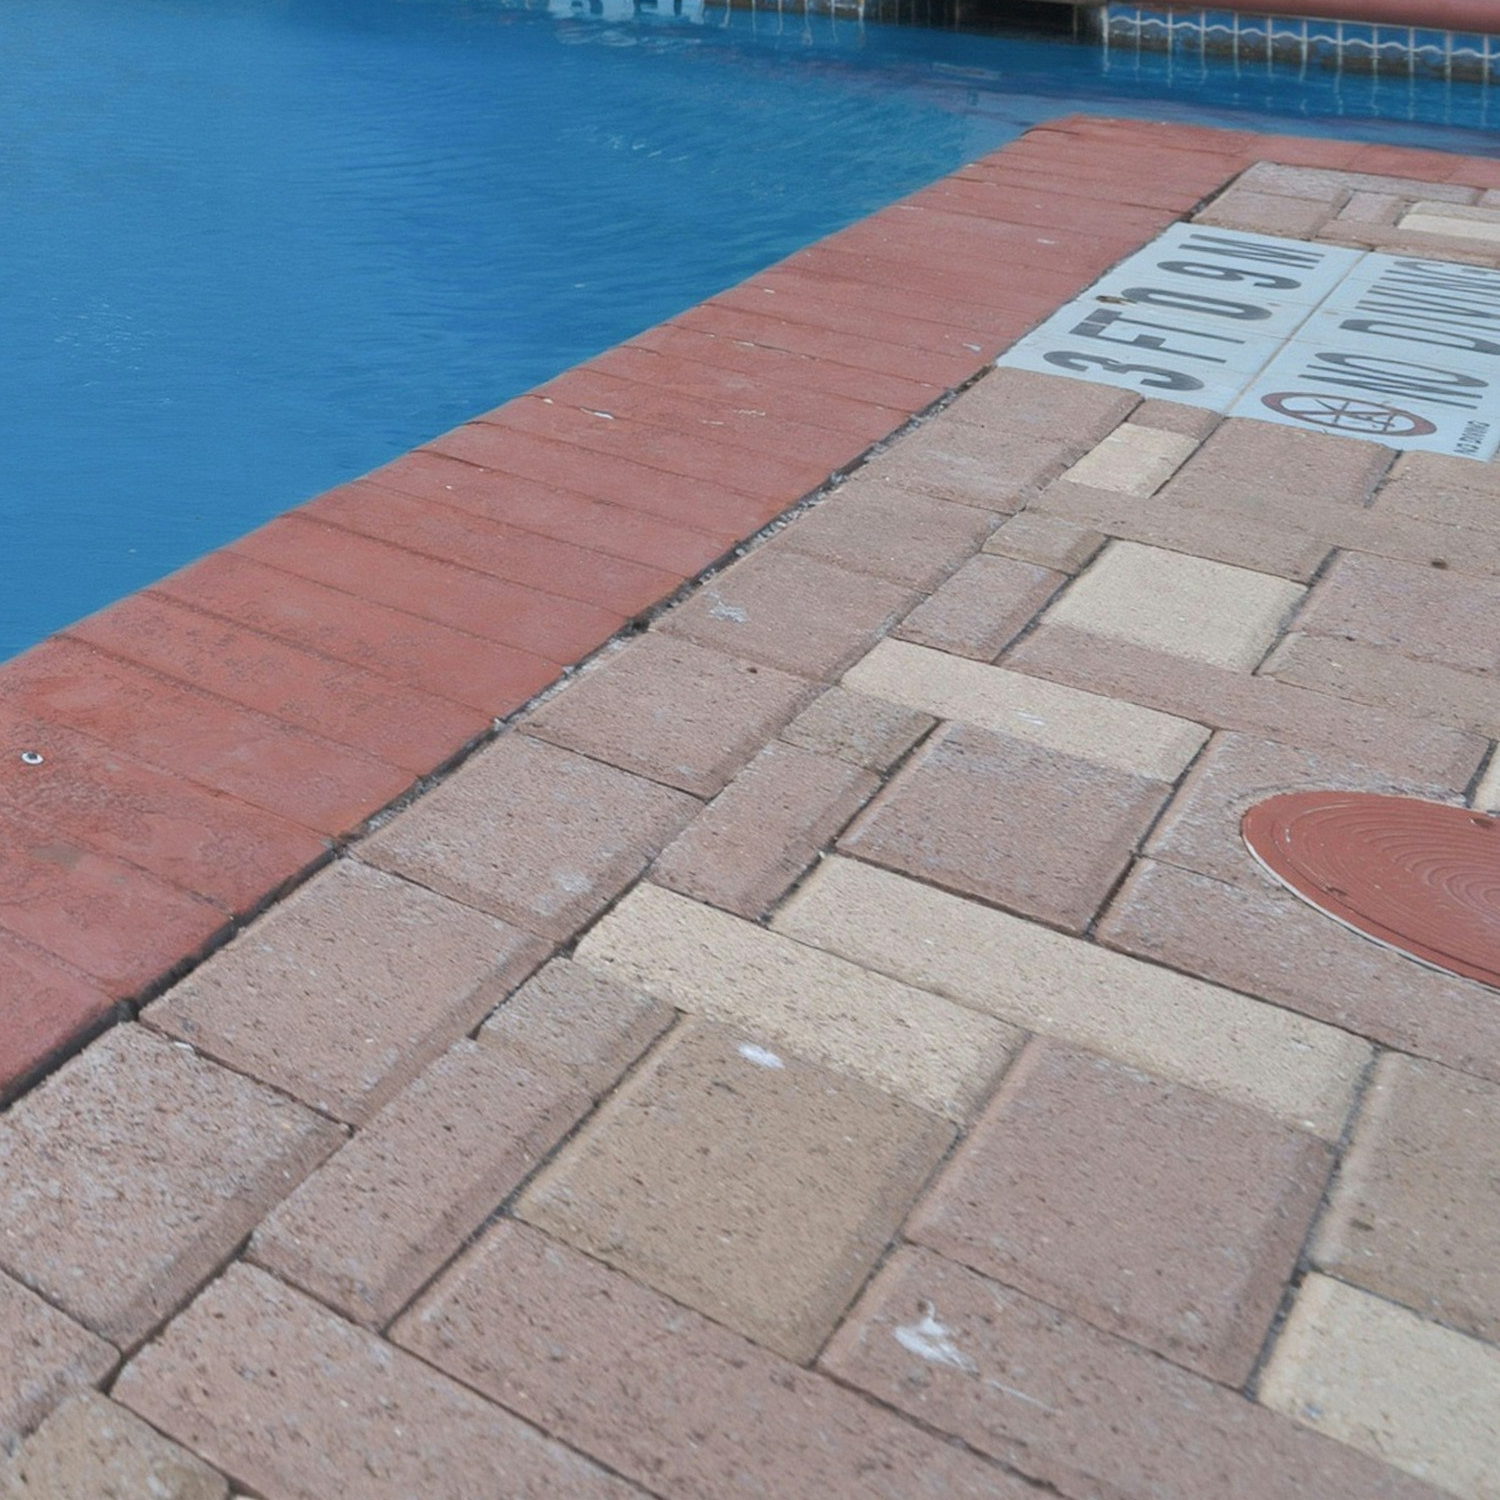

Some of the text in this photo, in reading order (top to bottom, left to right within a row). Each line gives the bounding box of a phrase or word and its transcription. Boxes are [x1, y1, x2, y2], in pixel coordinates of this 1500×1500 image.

[1069, 308, 1245, 363] FT
[1043, 351, 1204, 391] 3
[1298, 352, 1489, 409] NO
